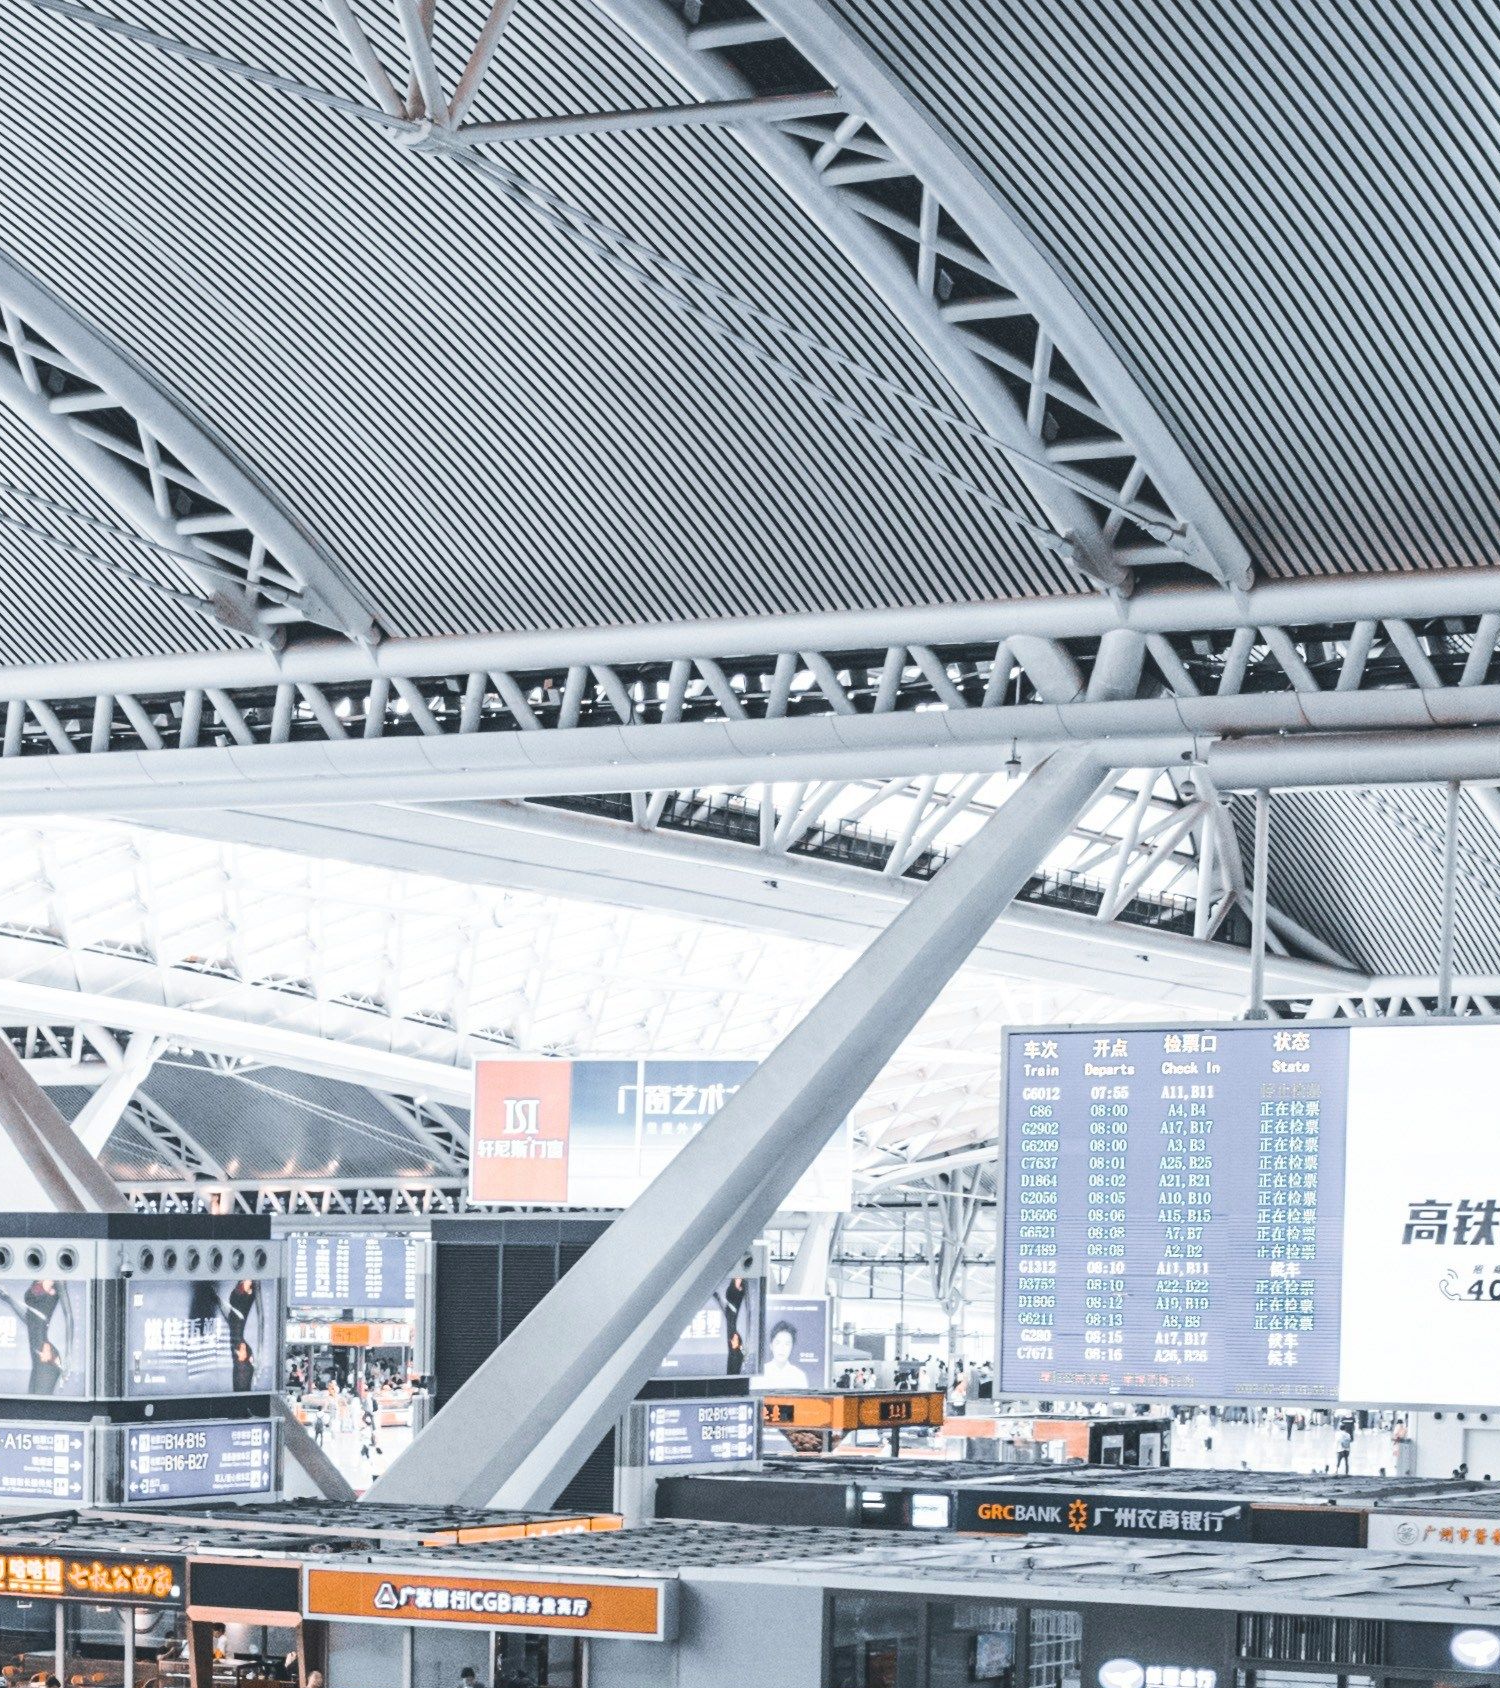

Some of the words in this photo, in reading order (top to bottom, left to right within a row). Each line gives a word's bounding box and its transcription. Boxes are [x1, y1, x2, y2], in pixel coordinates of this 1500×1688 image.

[1024, 1039, 1059, 1059] 车次
[1093, 1038, 1128, 1058] 开点
[1164, 1035, 1218, 1053] 检票口
[1273, 1032, 1311, 1052] 状态
[1024, 1065, 1059, 1077] Train
[1084, 1063, 1135, 1077] Departs
[1161, 1061, 1198, 1075] Check
[1206, 1061, 1220, 1074] In
[1271, 1061, 1310, 1074] State
[618, 1083, 740, 1115] 门窗艺术
[1090, 1104, 1128, 1117] 08:00
[1260, 1101, 1320, 1117] 正在检票
[1089, 1121, 1128, 1134] 08:00
[1160, 1121, 1213, 1135] A17,B17
[1259, 1119, 1320, 1135] 正在检票
[1089, 1139, 1127, 1152] 08:00
[1258, 1137, 1319, 1153] 正在检票
[1089, 1156, 1126, 1169] 08:01
[1159, 1156, 1212, 1170] A25,B25
[1258, 1154, 1319, 1171] 正在检票
[1088, 1174, 1126, 1187] 08:02
[1159, 1174, 1211, 1188] A21,B21
[1258, 1172, 1318, 1188] 正在检票
[1088, 1191, 1125, 1205] 08:05
[1159, 1191, 1211, 1206] A10,B10
[1257, 1190, 1317, 1207] 正在检票
[1257, 1208, 1317, 1225] 正在检票
[978, 1503, 1061, 1523] GRCBANK
[1094, 1507, 1224, 1532] 广州农商银行
